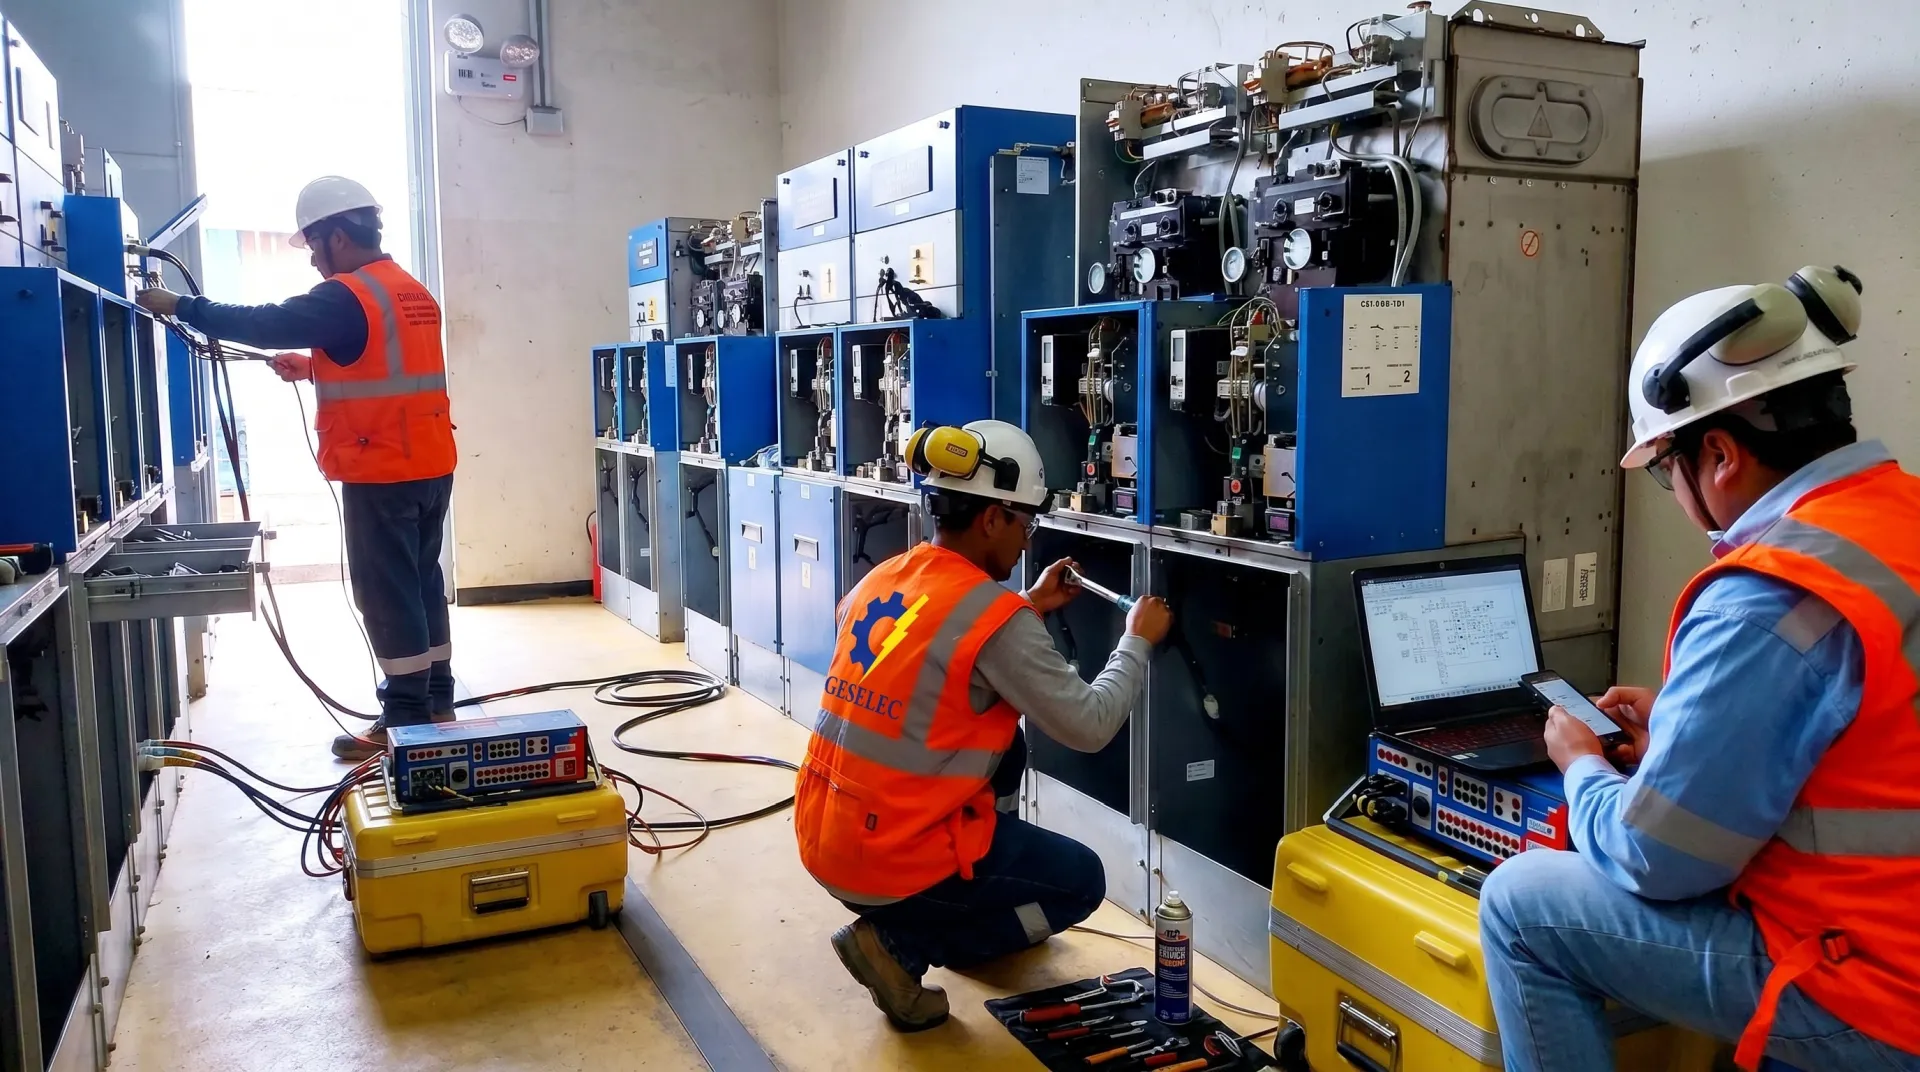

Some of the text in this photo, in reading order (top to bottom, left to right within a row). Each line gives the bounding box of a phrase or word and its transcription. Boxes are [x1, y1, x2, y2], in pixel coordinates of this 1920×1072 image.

[1365, 373, 1370, 386] 1
[1403, 369, 1411, 383] 2
[825, 676, 903, 720] GESELEC
